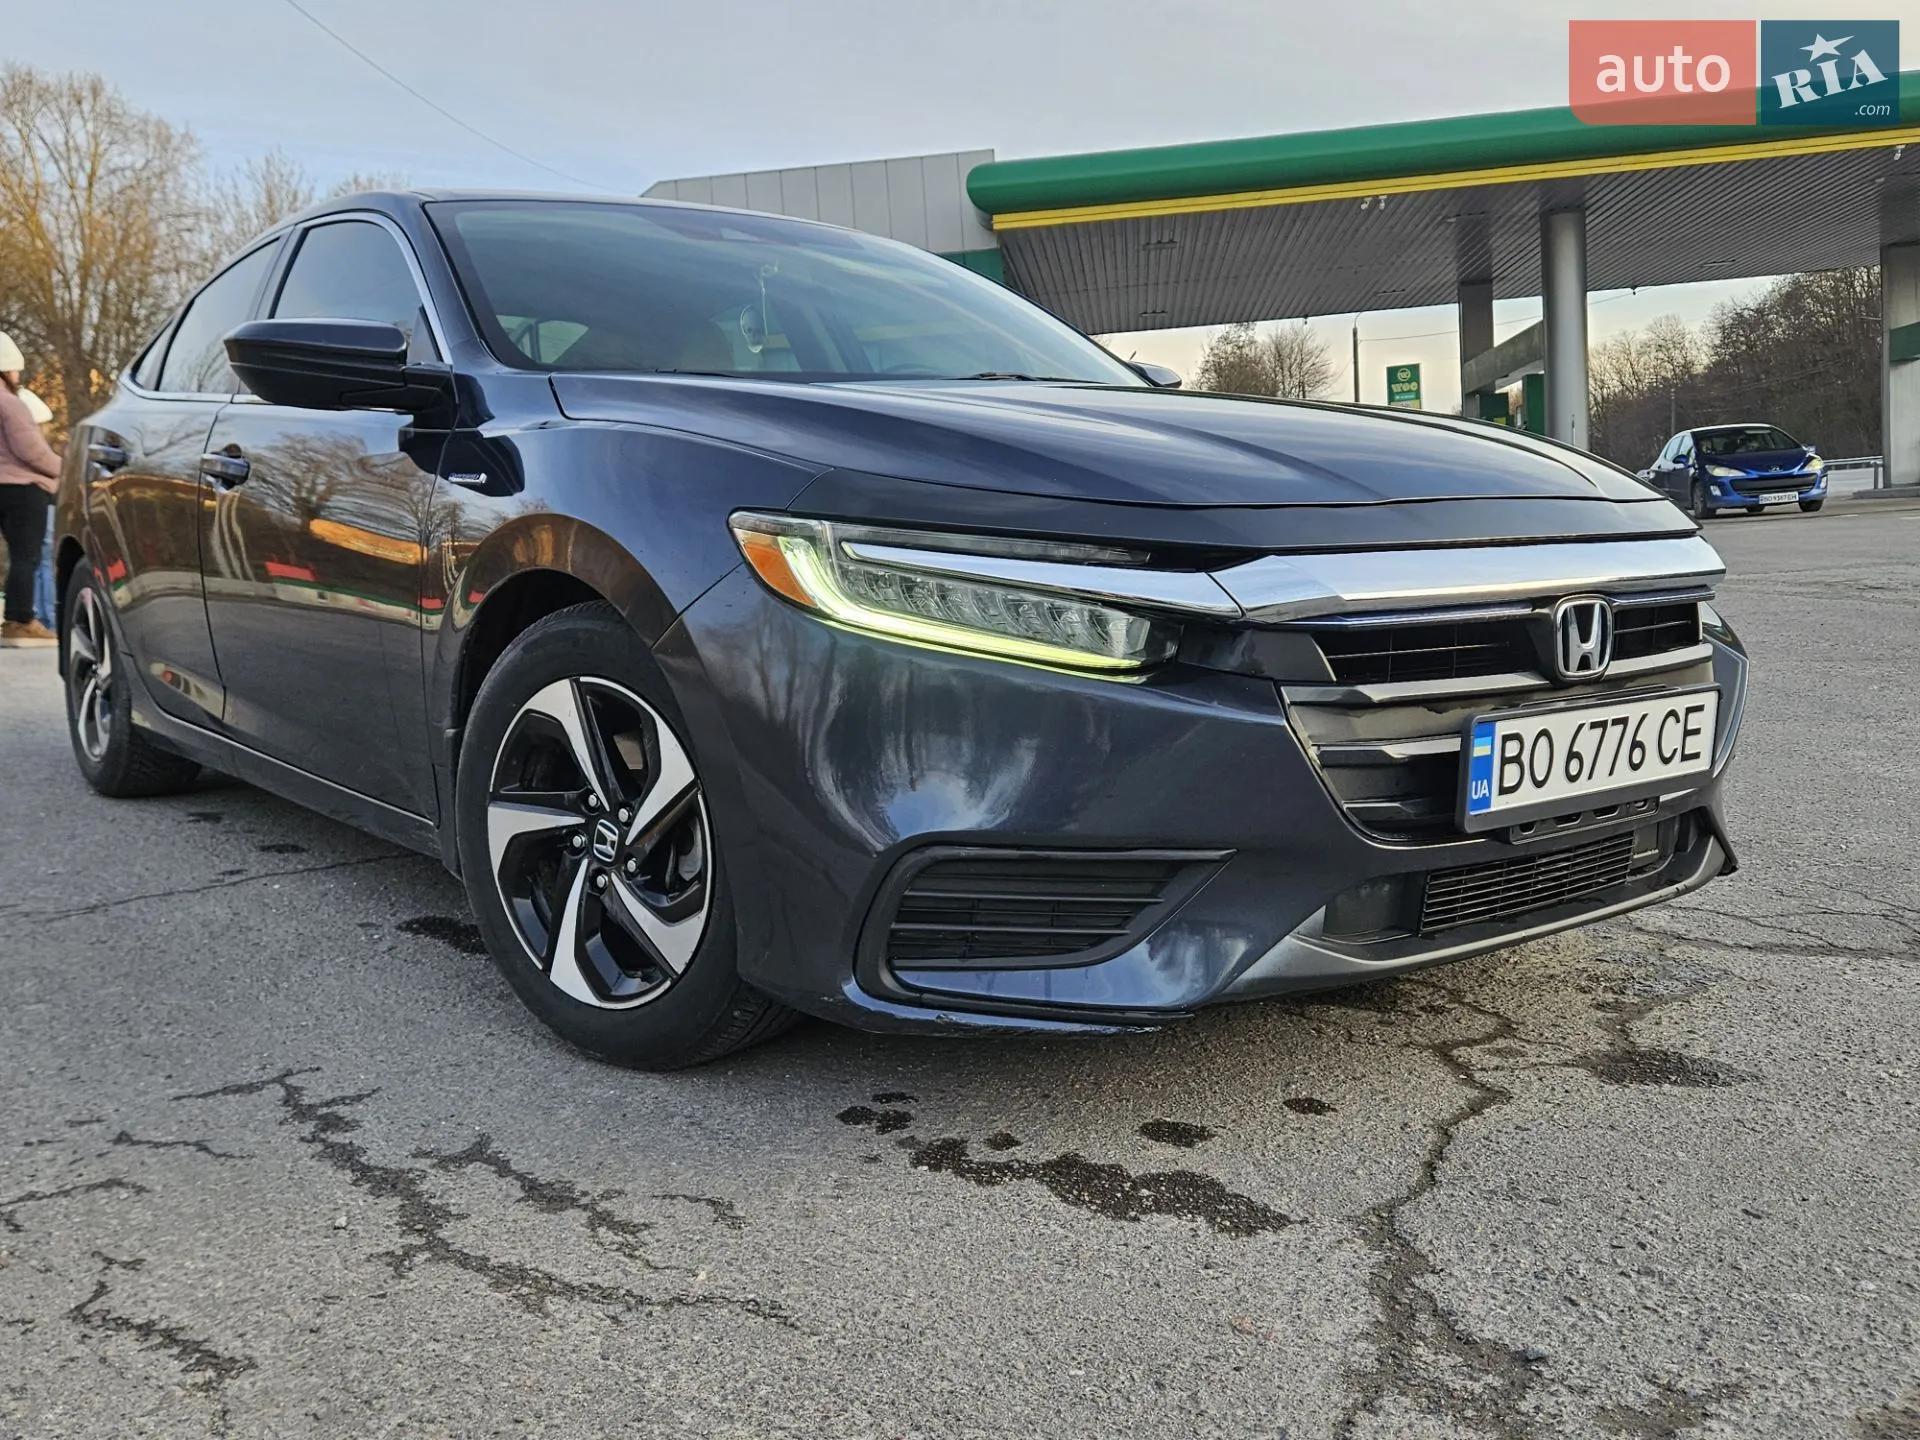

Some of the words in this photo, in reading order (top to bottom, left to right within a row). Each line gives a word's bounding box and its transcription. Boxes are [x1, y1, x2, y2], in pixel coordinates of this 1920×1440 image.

[1498, 727, 1555, 796] BO
[1564, 712, 1649, 783] 6776
[1657, 704, 1706, 765] CE
[1472, 778, 1490, 800] UA
